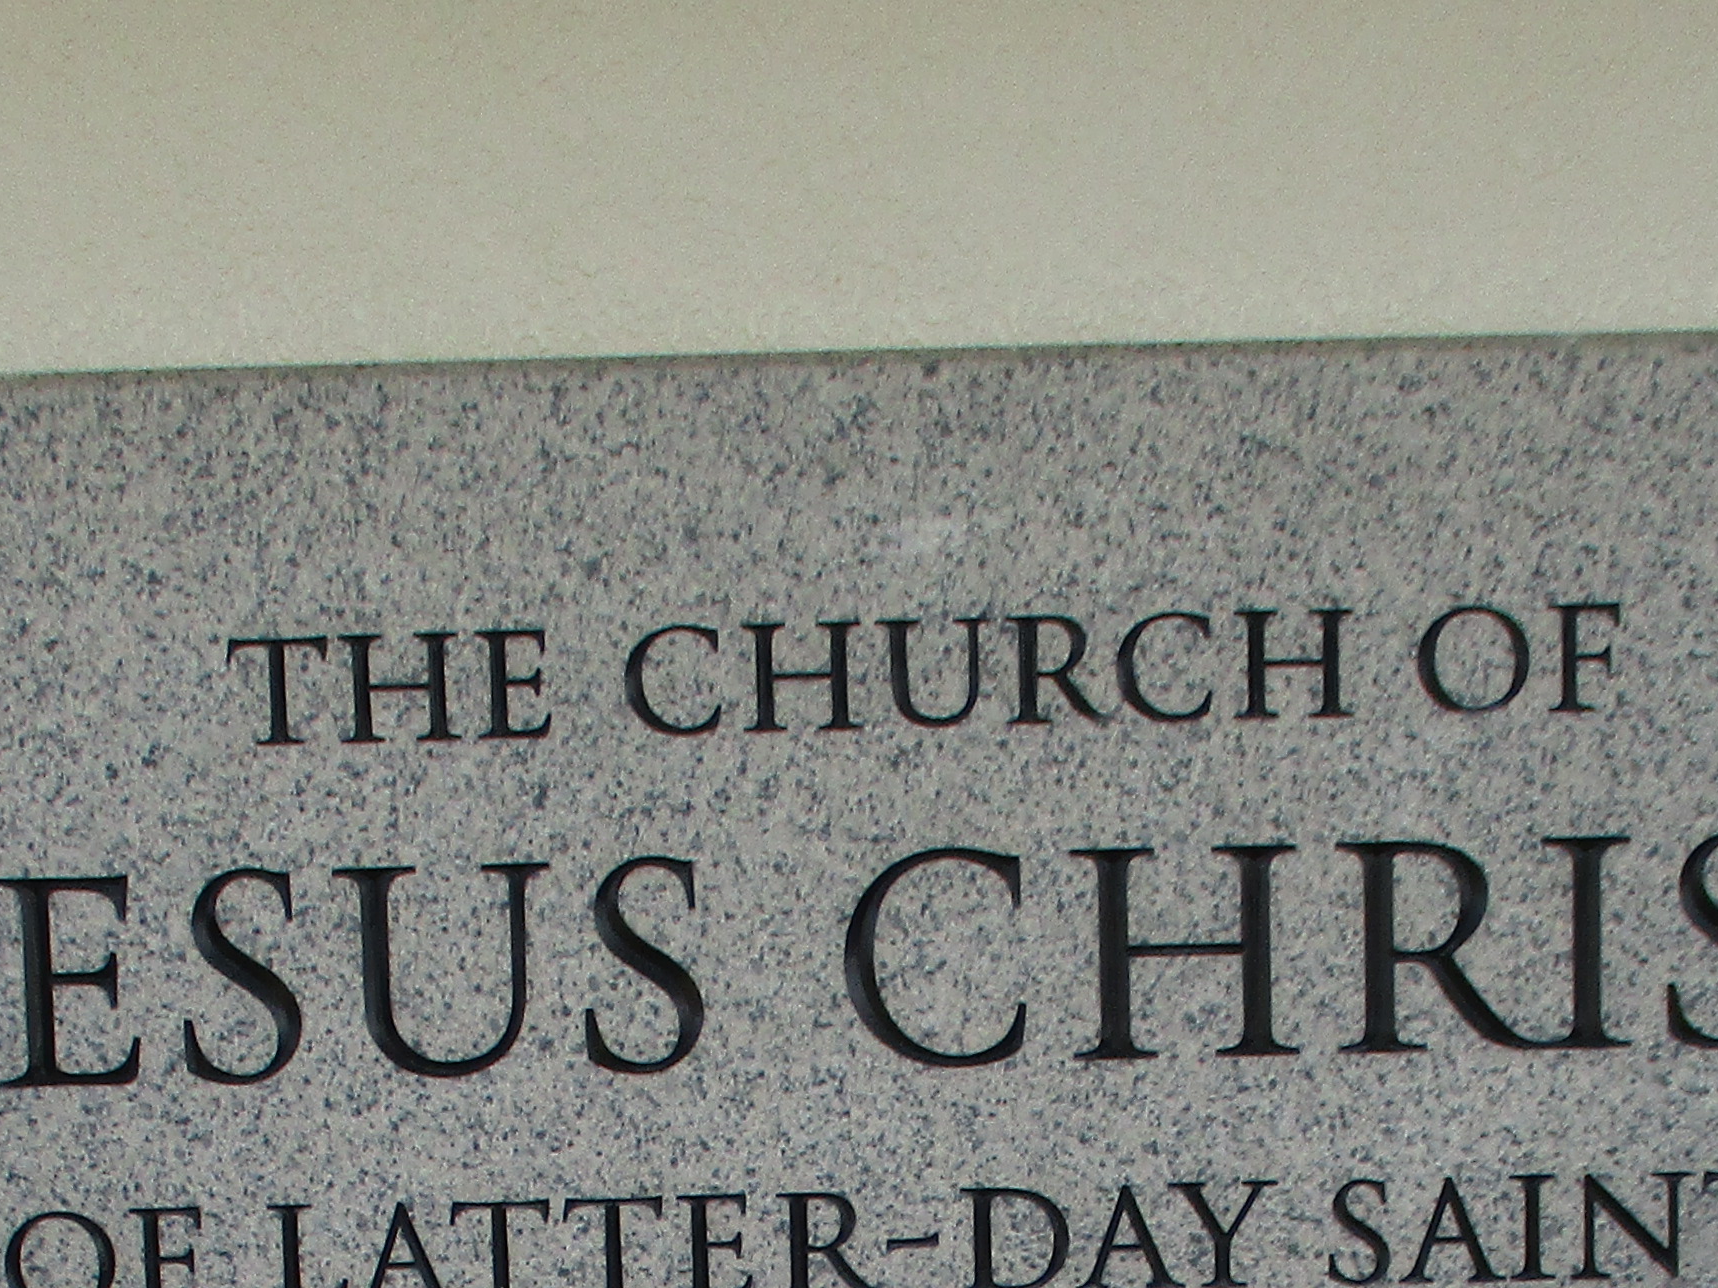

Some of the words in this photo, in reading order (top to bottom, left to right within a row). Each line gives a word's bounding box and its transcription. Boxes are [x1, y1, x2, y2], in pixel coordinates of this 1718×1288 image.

[225, 628, 553, 747] THE
[623, 606, 1353, 737] CHURCH
[1416, 600, 1621, 714] OF
